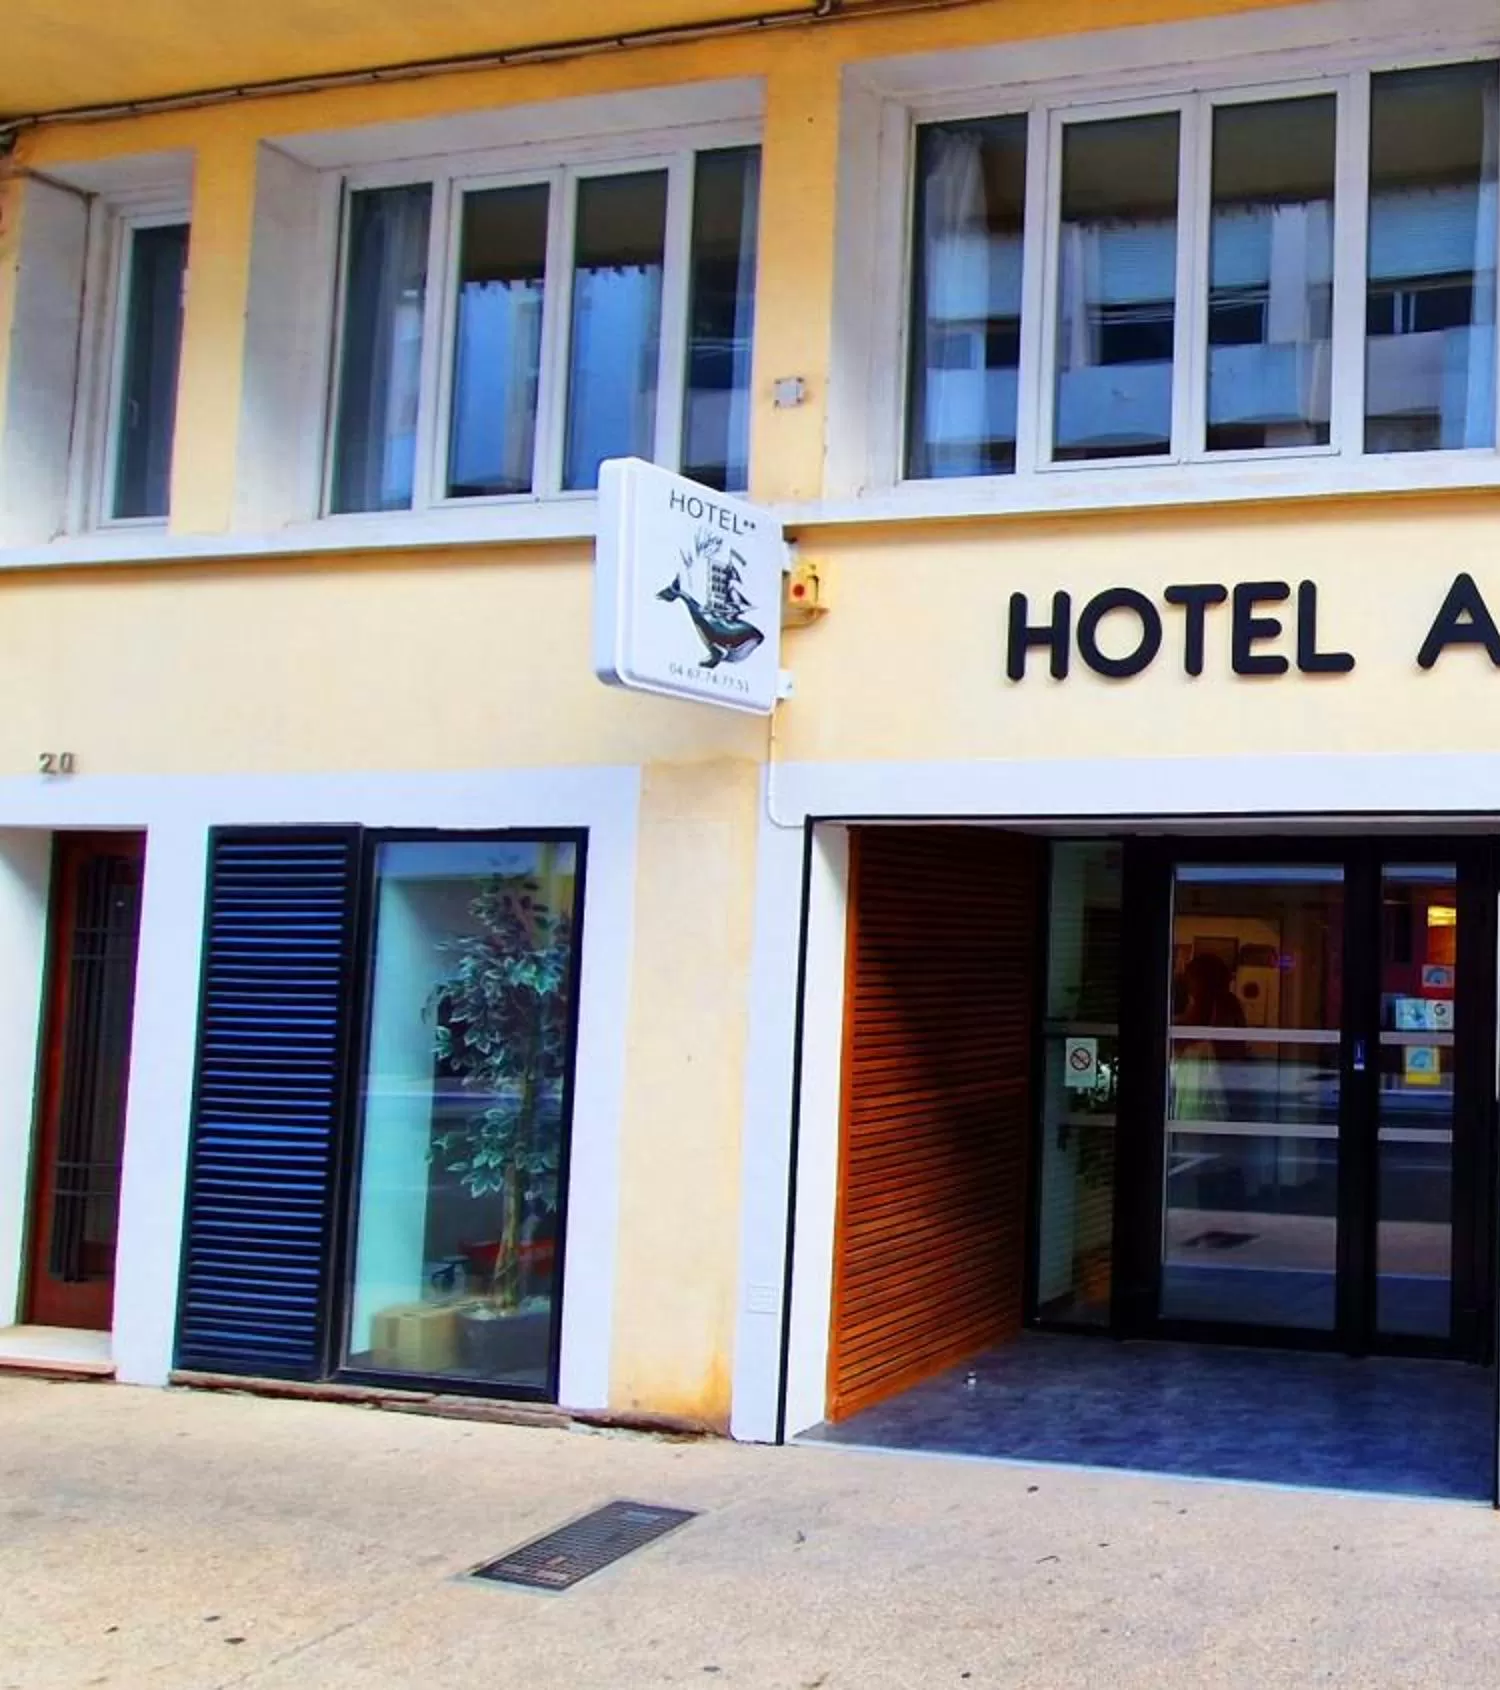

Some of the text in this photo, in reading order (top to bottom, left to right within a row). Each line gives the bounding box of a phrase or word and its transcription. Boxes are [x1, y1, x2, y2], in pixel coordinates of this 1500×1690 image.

[669, 489, 744, 535] HOTEL
[1006, 579, 1356, 682] HOTEL
[39, 751, 75, 776] 20
